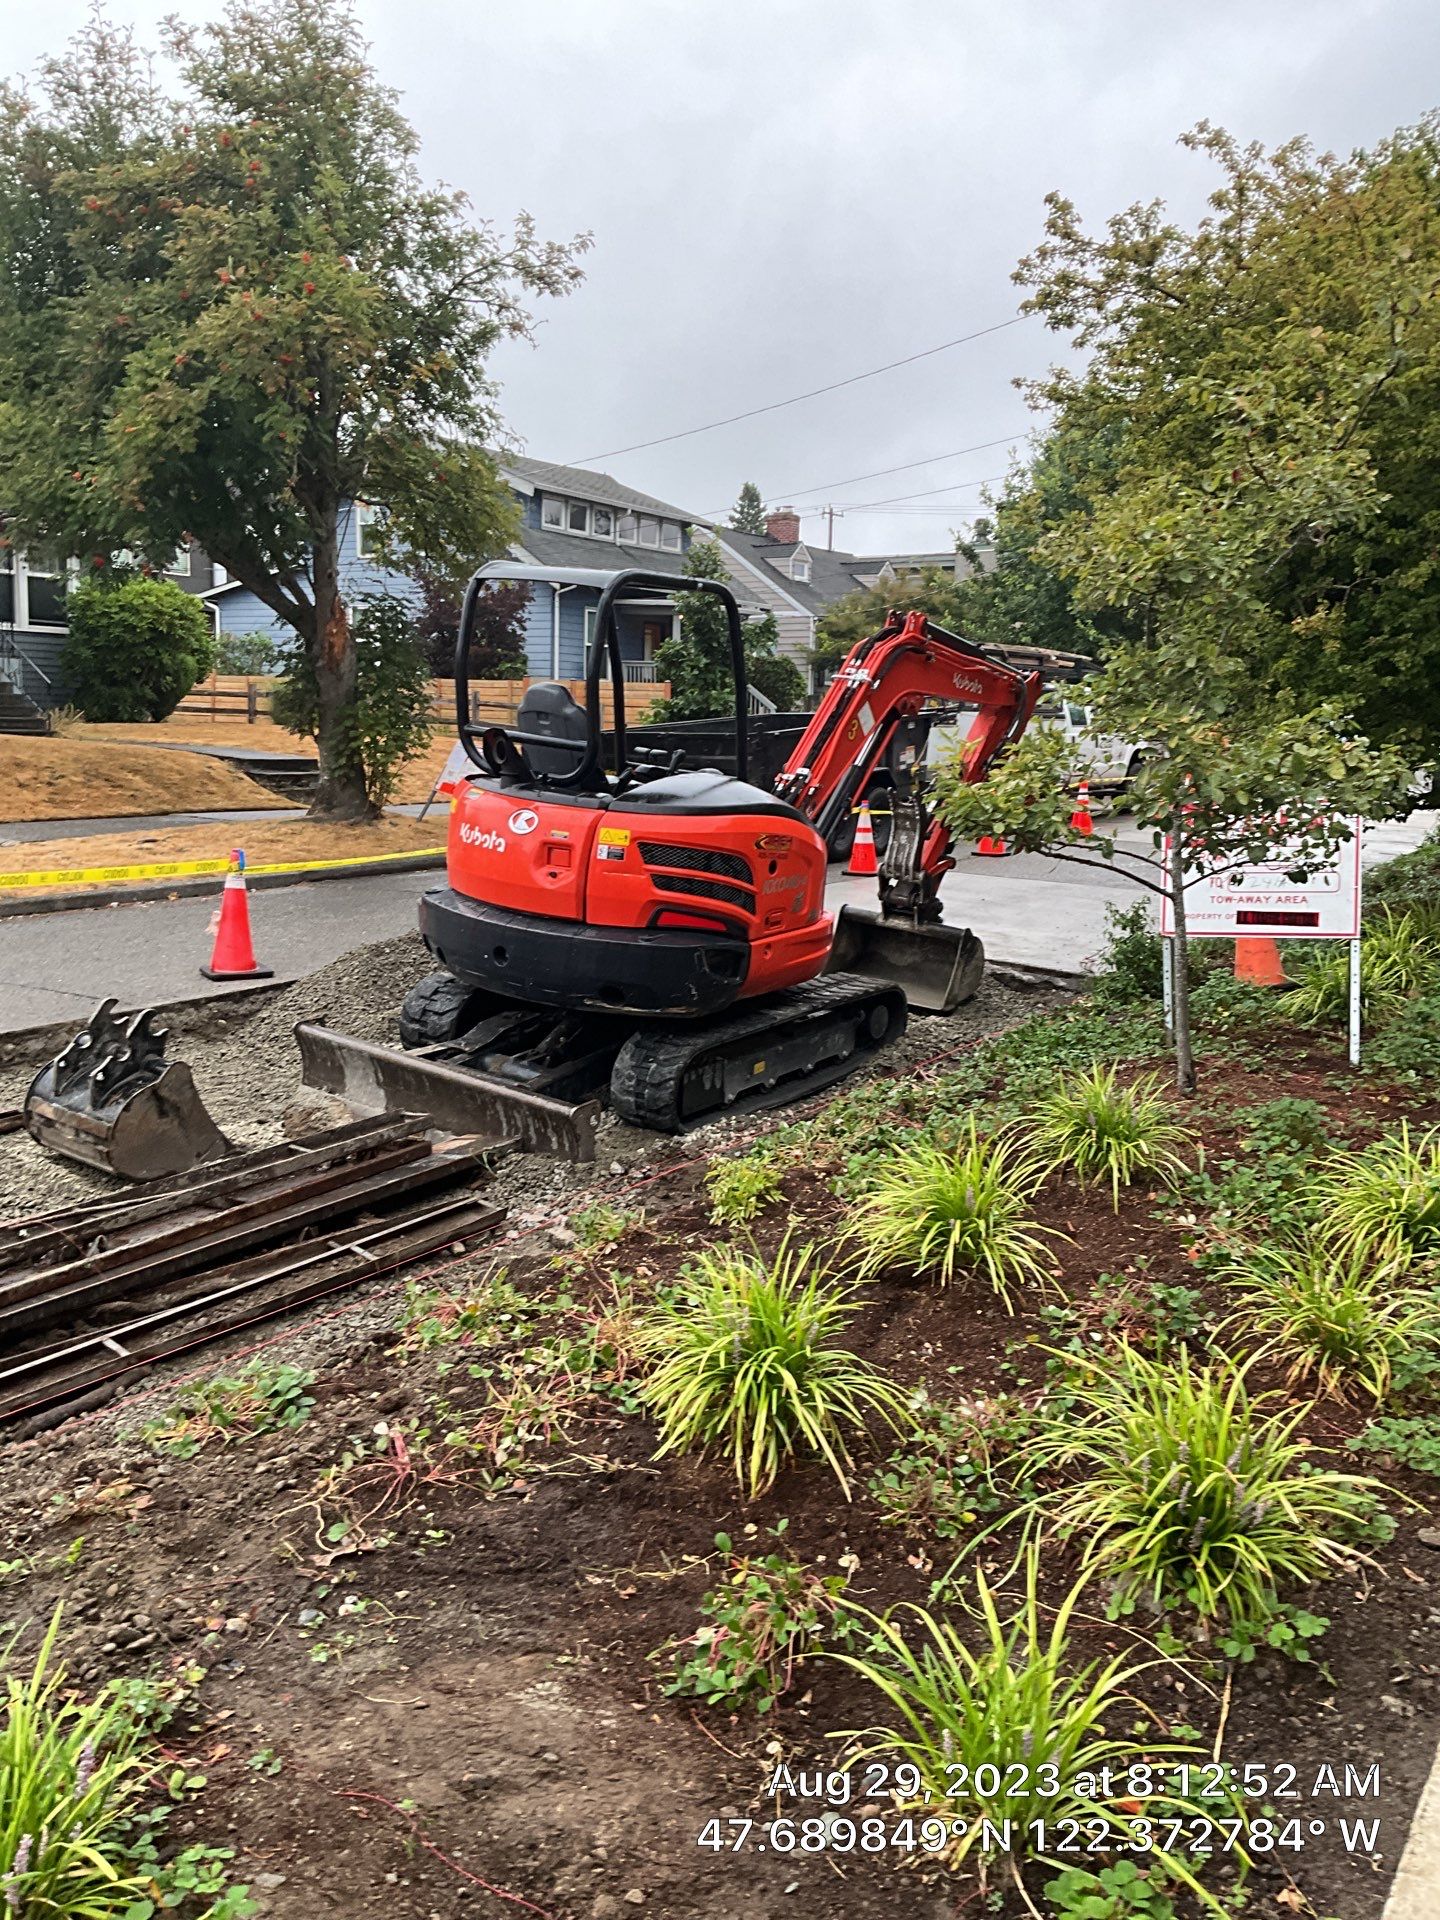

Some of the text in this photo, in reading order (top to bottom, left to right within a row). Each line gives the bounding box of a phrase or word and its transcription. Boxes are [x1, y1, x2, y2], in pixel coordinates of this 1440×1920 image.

[953, 672, 983, 694] Kubota
[460, 822, 506, 853] Kubota
[1210, 895, 1308, 904] TOW-AWAY AREA
